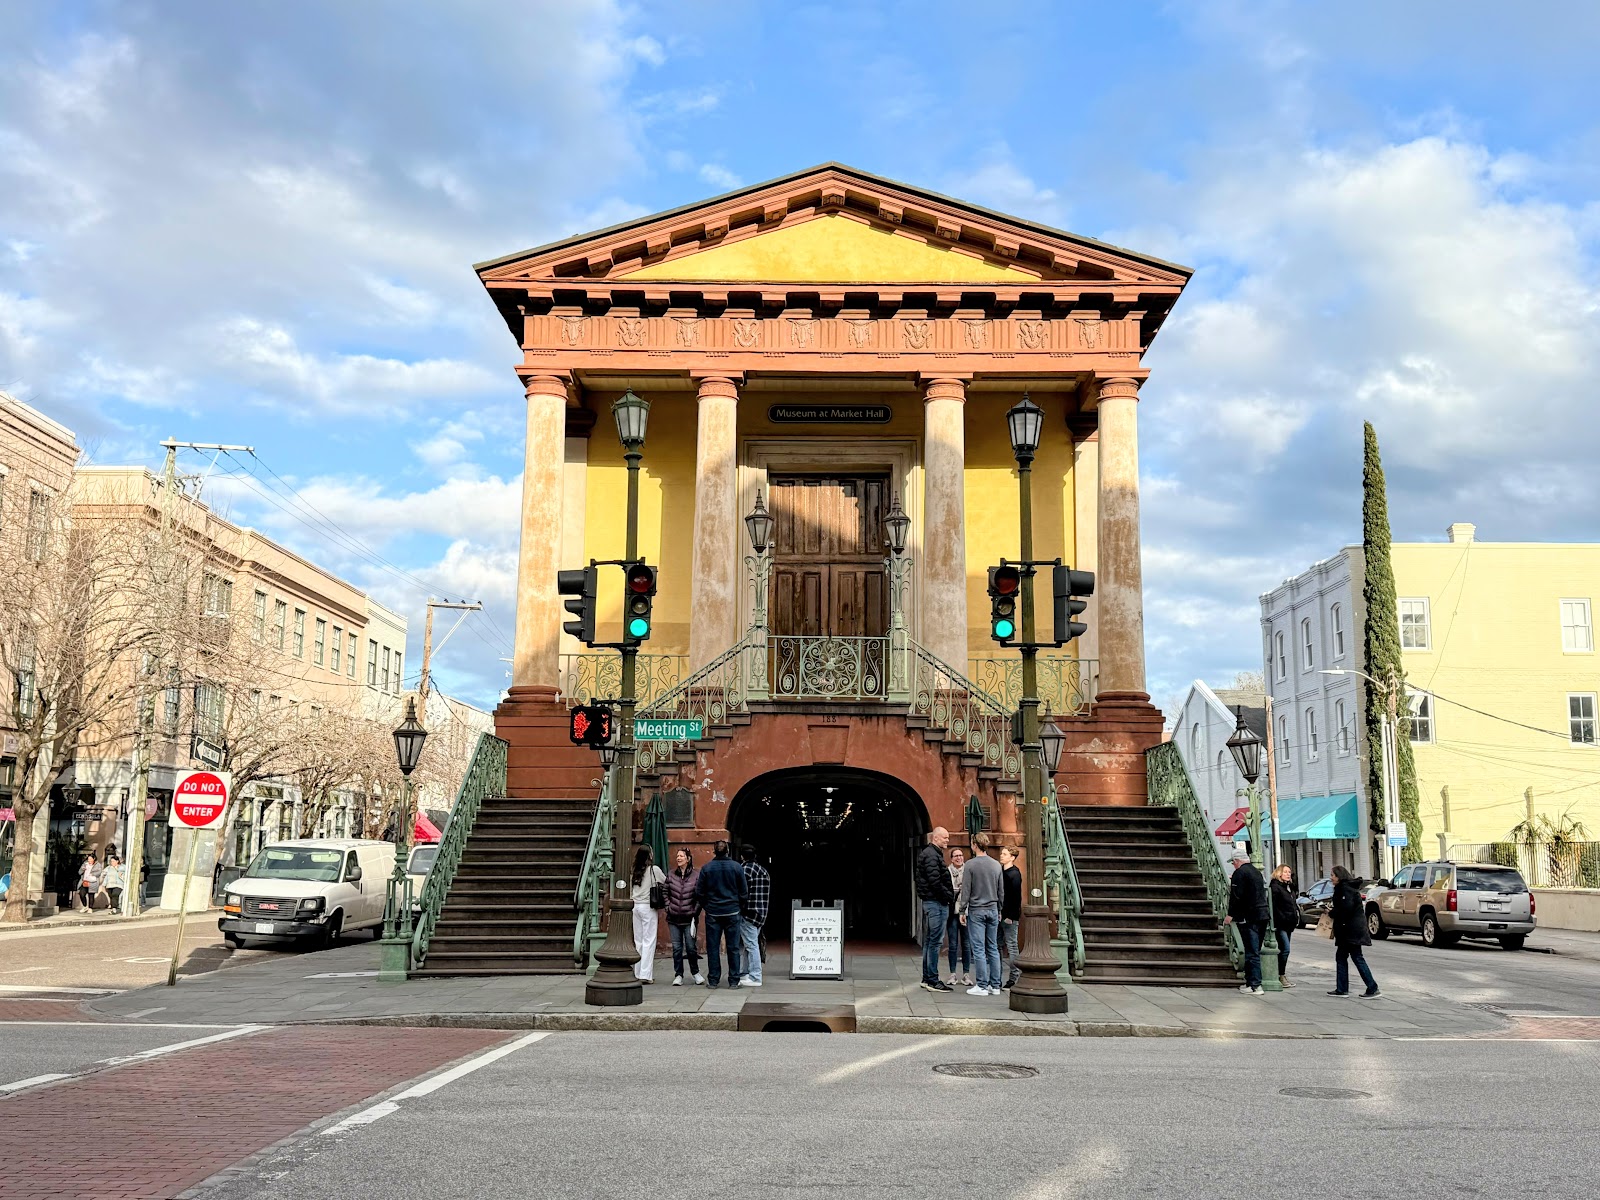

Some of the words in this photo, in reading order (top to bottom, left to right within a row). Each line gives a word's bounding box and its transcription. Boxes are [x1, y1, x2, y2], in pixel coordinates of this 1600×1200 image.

[776, 409, 817, 418] Museum
[819, 410, 828, 418] at
[830, 409, 863, 418] Market
[866, 409, 884, 418] Hall
[637, 721, 687, 739] Meeting
[689, 721, 699, 732] St
[183, 782, 198, 792] DO
[200, 782, 222, 793] NOT
[182, 806, 213, 817] ENTER
[801, 927, 833, 935] CITY
[800, 955, 816, 963] Open
